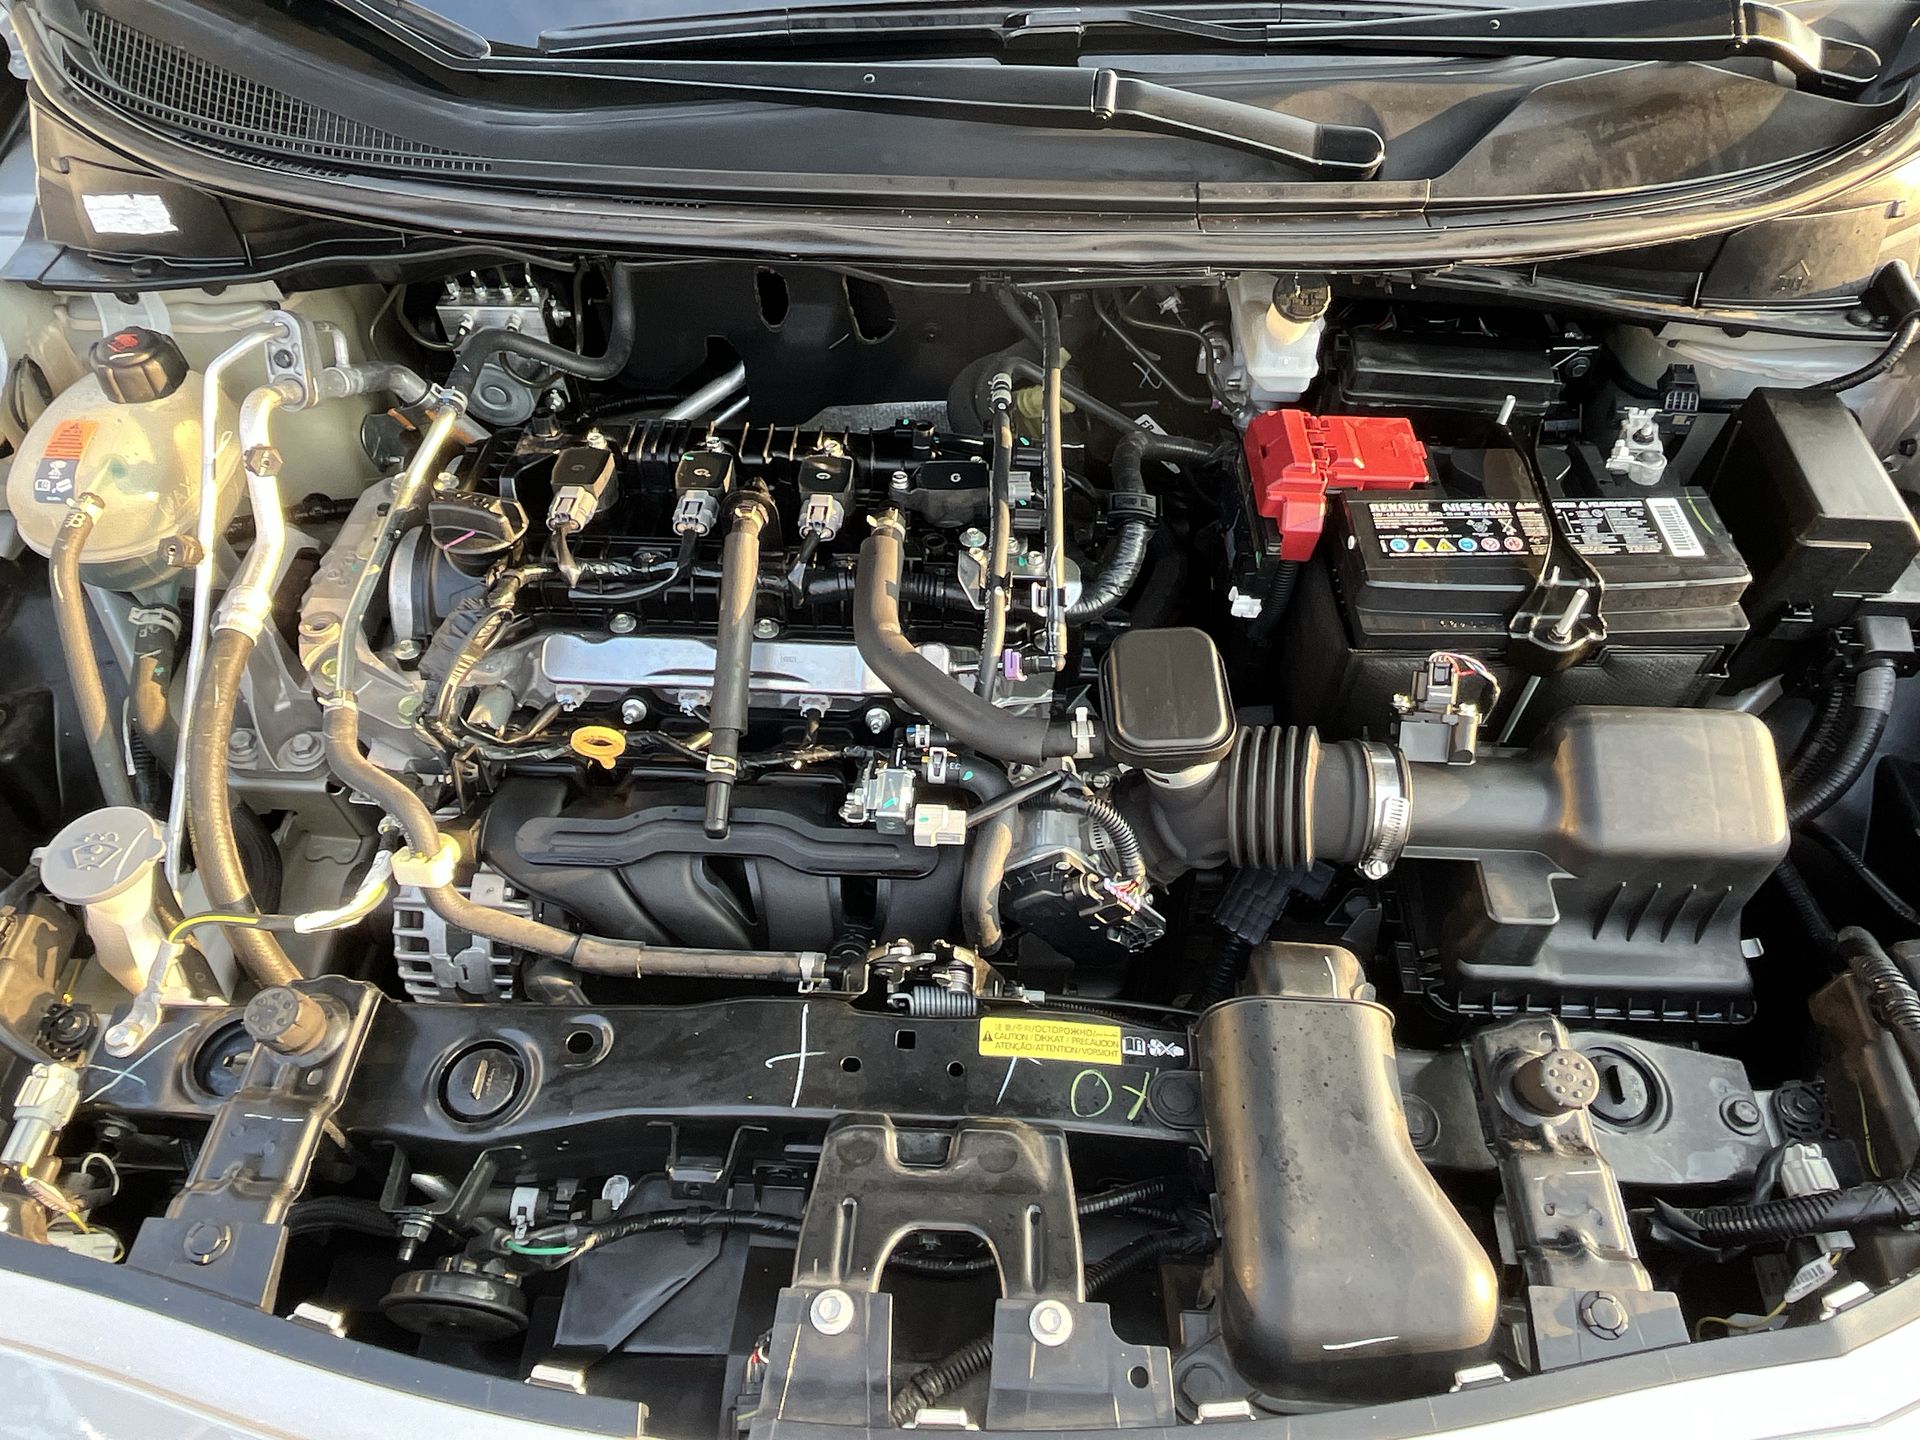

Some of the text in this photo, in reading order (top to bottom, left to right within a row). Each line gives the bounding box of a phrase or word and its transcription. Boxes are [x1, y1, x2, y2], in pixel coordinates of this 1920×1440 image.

[1368, 503, 1429, 512] RENAULT
[1441, 502, 1510, 512] NISSAN
[994, 1032, 1029, 1041] CAUTION
[1035, 1034, 1064, 1043] DIKKAT
